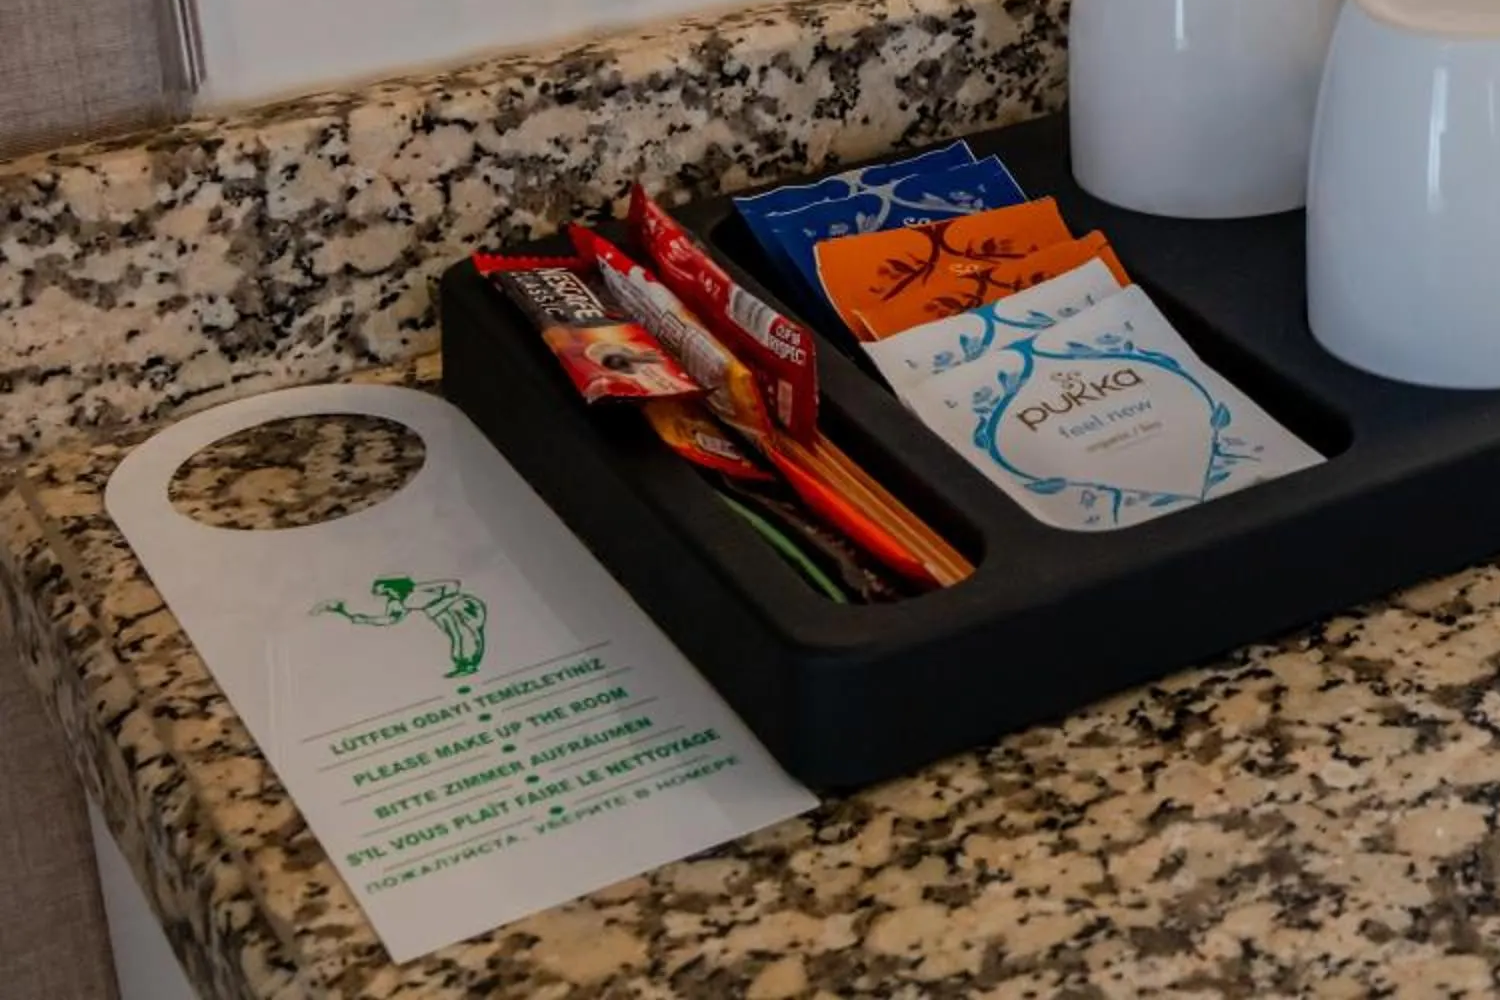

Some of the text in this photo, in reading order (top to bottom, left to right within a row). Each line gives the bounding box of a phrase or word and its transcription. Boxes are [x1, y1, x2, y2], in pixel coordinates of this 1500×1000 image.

[1016, 368, 1143, 433] pukka
[1058, 414, 1105, 439] feel
[1108, 399, 1153, 423] new
[331, 723, 408, 755] LÜTFEN
[412, 701, 472, 729] ODAYI
[353, 686, 629, 787] PLEASE MAKE UP THE ROOM
[346, 845, 387, 868] S'IL
[389, 822, 449, 851] VOUS
[515, 779, 571, 806] FAIRE
[576, 768, 604, 787] LE
[605, 728, 721, 777] NETTOYAGE
[374, 789, 438, 820] BITTE
[444, 759, 525, 796] ZIMMER
